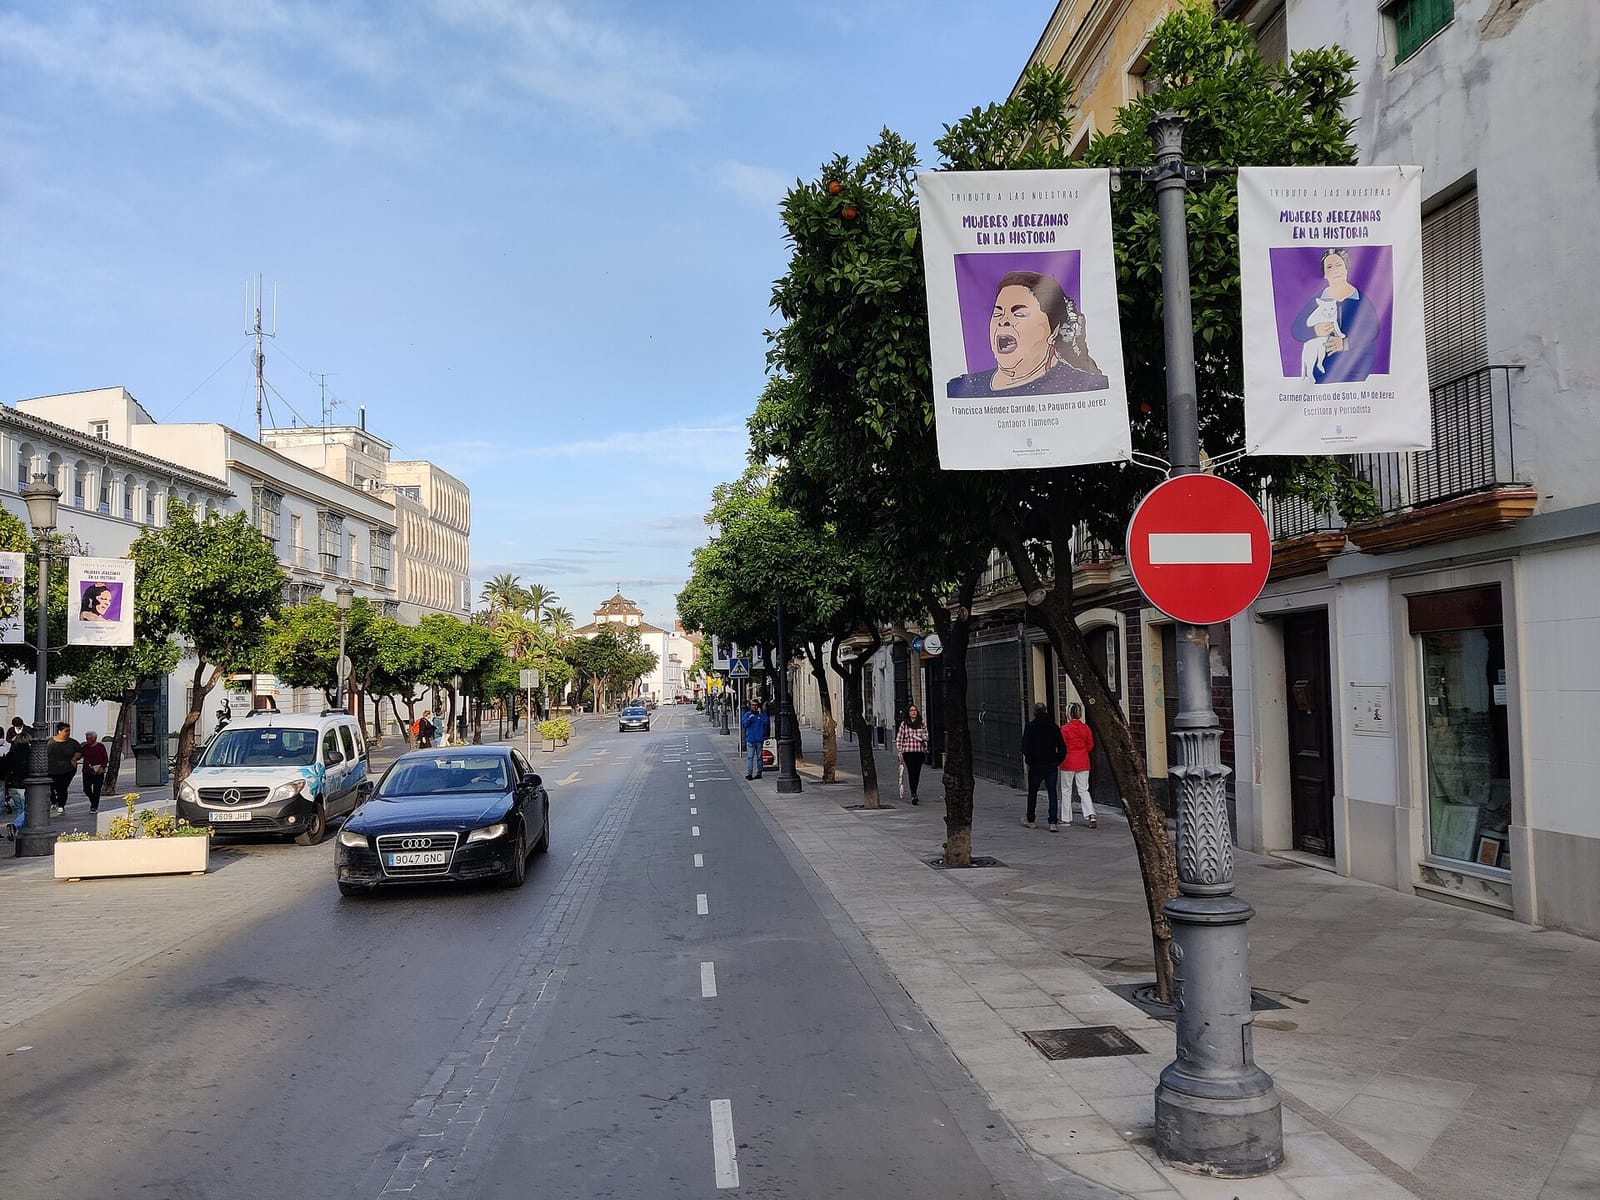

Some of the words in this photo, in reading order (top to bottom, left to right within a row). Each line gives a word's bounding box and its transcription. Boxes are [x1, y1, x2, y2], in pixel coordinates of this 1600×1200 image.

[951, 192, 991, 202] TRIBUTO
[998, 192, 1002, 201] A
[1009, 191, 1025, 201] LAS
[1032, 190, 1079, 200] NUESTRAS
[1270, 189, 1307, 198] TRIBUTO
[1324, 188, 1340, 197] LAS
[1346, 188, 1391, 197] NUESTRAS
[962, 214, 1009, 229] MUJERES
[1012, 213, 1069, 228] JEREZANAS
[1280, 210, 1323, 223] MUJERES
[1326, 210, 1382, 223] JEREZANAS
[976, 232, 990, 245] EN
[993, 231, 1006, 245] LA
[1009, 230, 1056, 244] HISTORIA
[1293, 226, 1306, 240] EN
[1309, 226, 1320, 239] LA
[1323, 226, 1369, 239] HISTORIA
[1278, 393, 1302, 402] Carmen
[1303, 392, 1332, 402] Carriedo
[1332, 392, 1341, 401] de
[1341, 391, 1360, 401] Soto,
[1371, 391, 1378, 400] de
[951, 405, 983, 416] Francisca
[984, 404, 1010, 415] Méndez
[1010, 403, 1038, 414] Garrido,
[1038, 403, 1047, 412] La
[1047, 401, 1076, 413] Paquera
[1077, 400, 1086, 409] de
[1087, 398, 1107, 408] Jerez
[1303, 407, 1333, 416] Escritora
[1339, 405, 1371, 415] Periodista
[997, 418, 1027, 429] Cantaora
[1028, 417, 1060, 428] Flamenca
[214, 813, 233, 821] 2609
[395, 854, 420, 865] 9047
[423, 853, 442, 863] GNC
